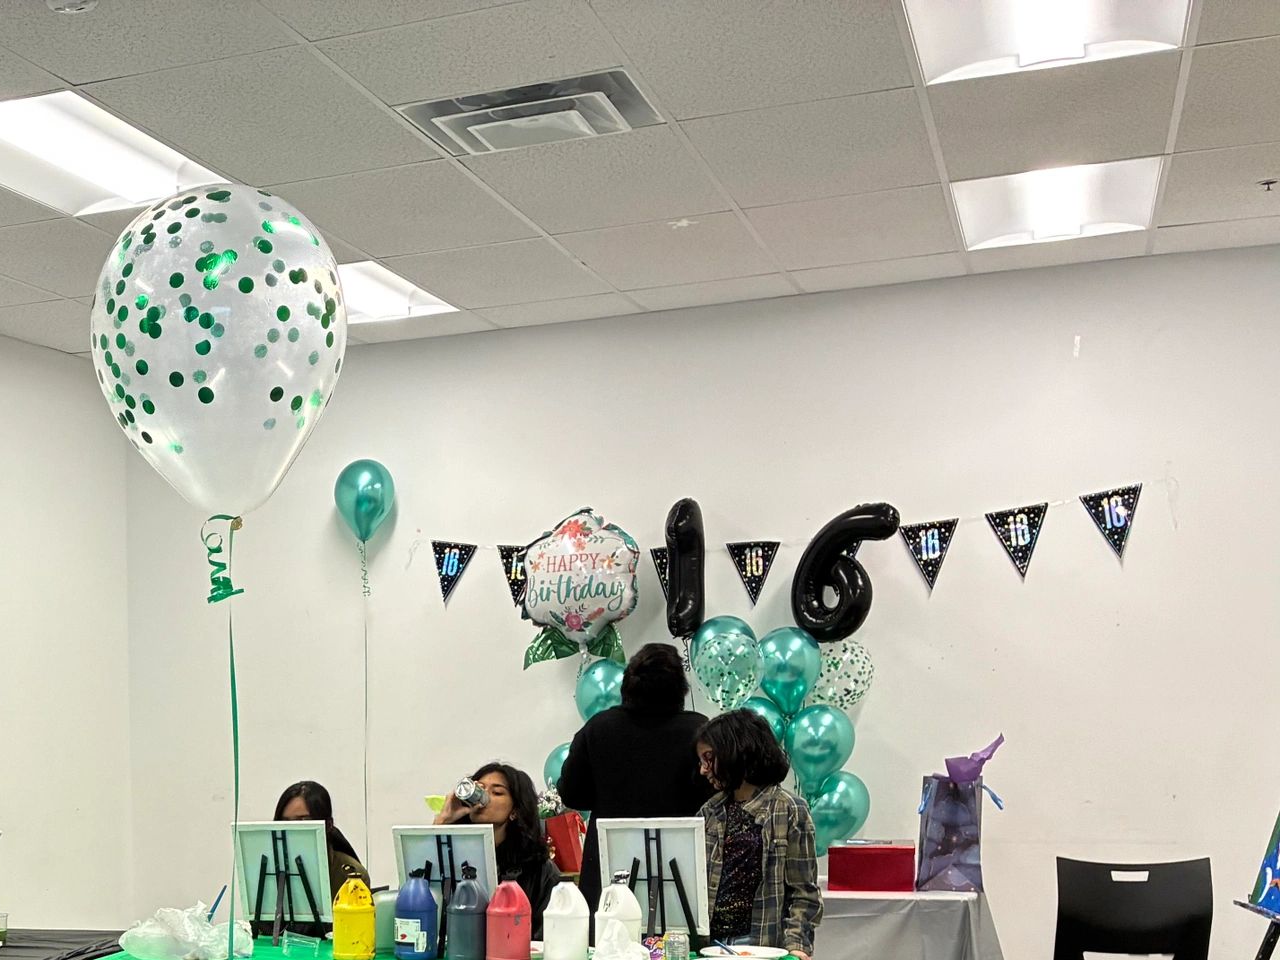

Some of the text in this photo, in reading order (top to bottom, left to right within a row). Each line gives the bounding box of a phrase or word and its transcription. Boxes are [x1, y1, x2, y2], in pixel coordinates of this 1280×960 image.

[1101, 494, 1128, 531] 16
[919, 528, 941, 561] 16
[441, 547, 460, 576] 16
[546, 552, 600, 573] HAPPY
[744, 546, 763, 577] 16
